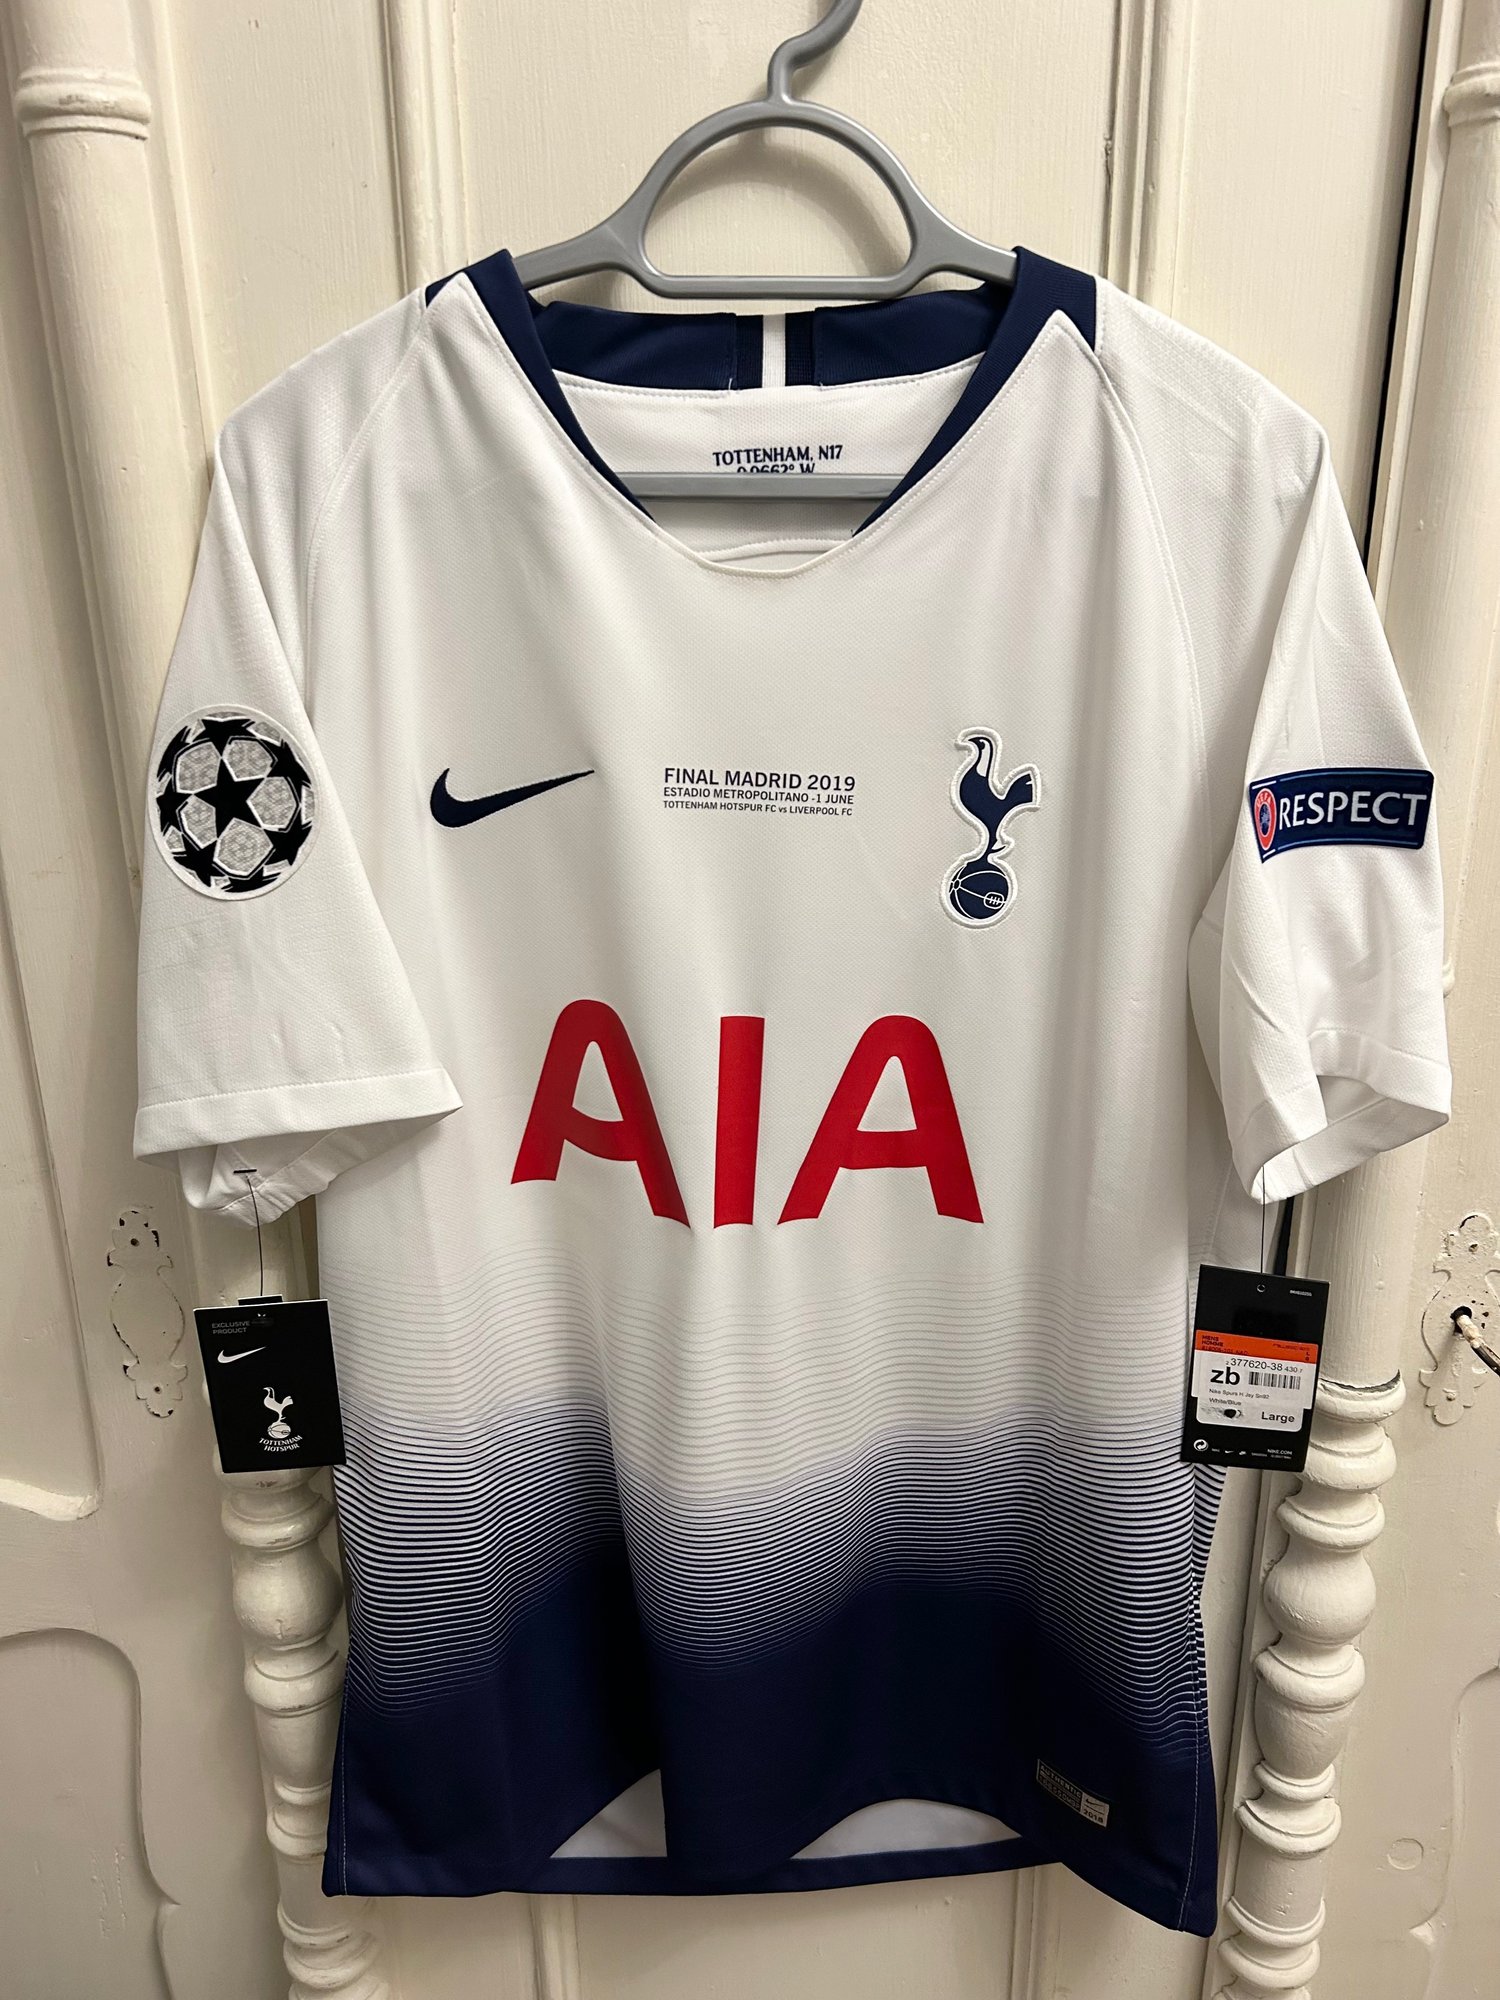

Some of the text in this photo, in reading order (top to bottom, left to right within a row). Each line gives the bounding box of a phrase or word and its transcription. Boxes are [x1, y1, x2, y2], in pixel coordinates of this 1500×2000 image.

[712, 444, 843, 466] TOTTENHAM, N17
[664, 767, 855, 792] FINAL MADRID 2019
[663, 786, 711, 798] ESTADIO
[713, 788, 809, 803] METROPOLITANO
[825, 793, 854, 805] JUNE
[663, 800, 853, 817] TOTTENHAM HOTSPUR FC vs LIVERPOOL FC
[1279, 791, 1427, 830] RESPECT
[511, 999, 985, 1229] AIA
[211, 1320, 250, 1329] EXCLUSIVE
[212, 1327, 247, 1335] PRODUCT
[1230, 1357, 1283, 1372] 377620-38
[1210, 1366, 1241, 1386] zb
[1208, 1397, 1242, 1406] White/Blue
[1261, 1411, 1295, 1424] Large
[259, 1435, 303, 1446] TOTTENHAM
[263, 1443, 300, 1452] HOTSPUR
